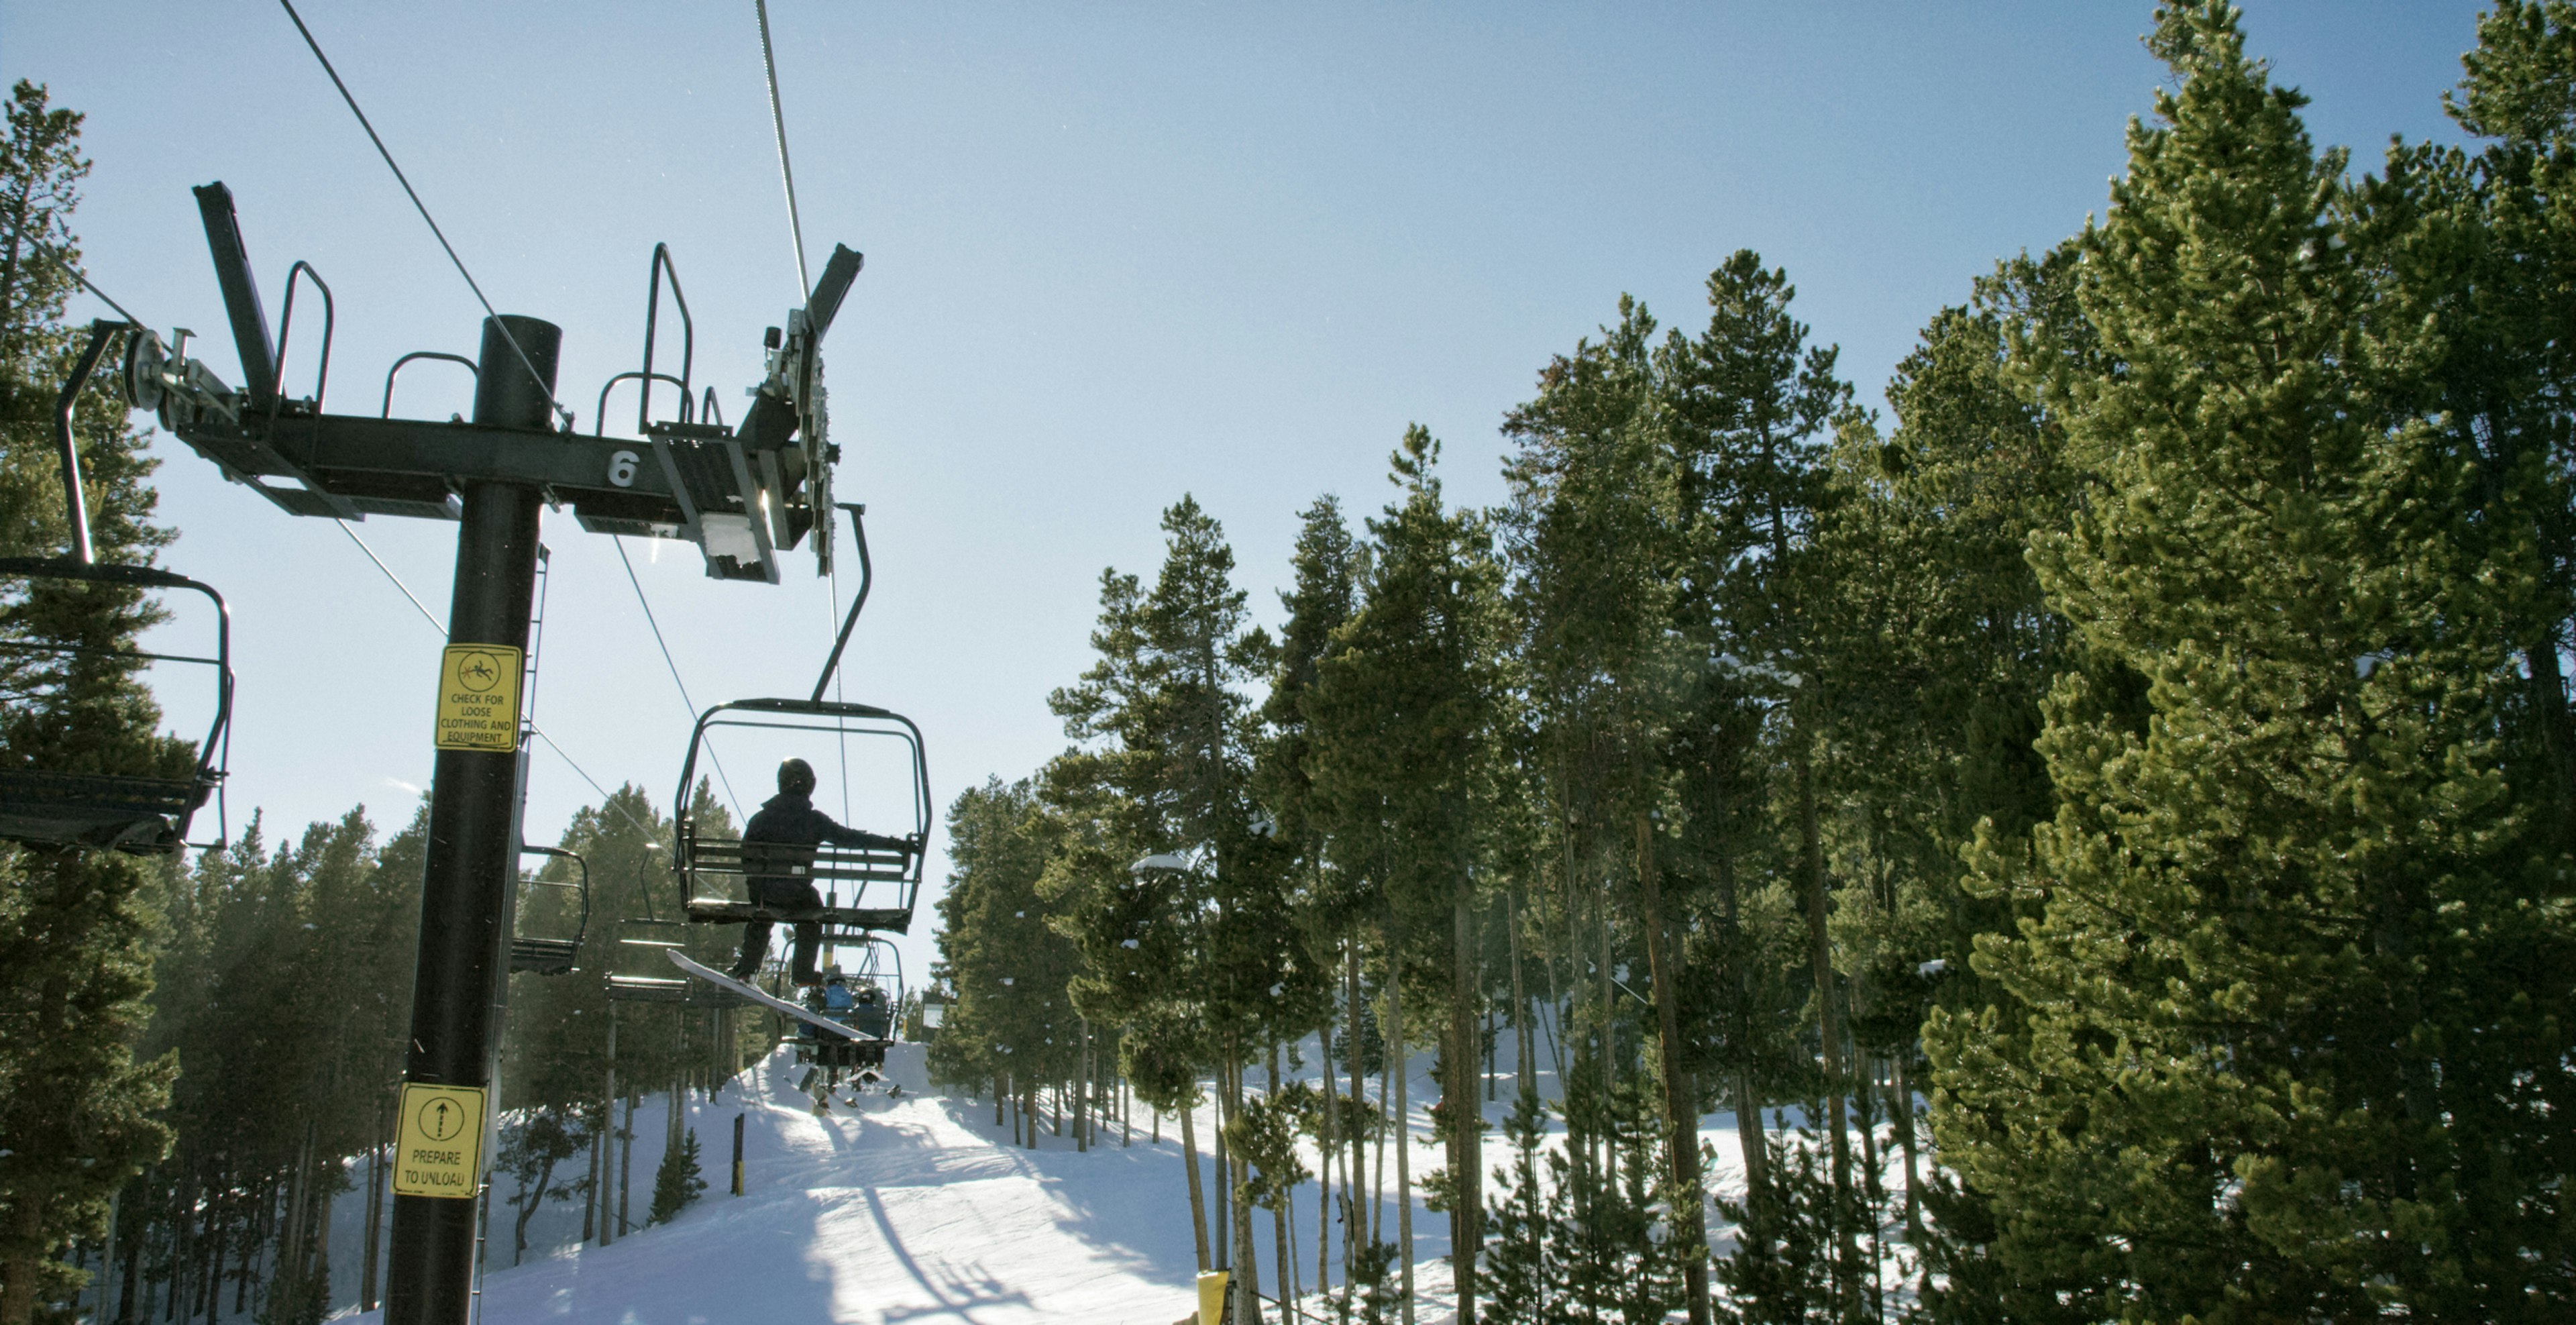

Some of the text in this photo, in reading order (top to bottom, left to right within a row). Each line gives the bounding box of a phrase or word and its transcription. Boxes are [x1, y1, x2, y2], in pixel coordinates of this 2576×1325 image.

[608, 450, 640, 487] 6
[451, 694, 503, 704] CHECK FOR
[462, 707, 491, 717] LOOSE
[441, 719, 511, 731] CLOTHING AND
[447, 732, 502, 742] EQUIPMENT
[413, 1150, 461, 1165] PREPARE
[405, 1170, 465, 1186] TO UNLOAD
